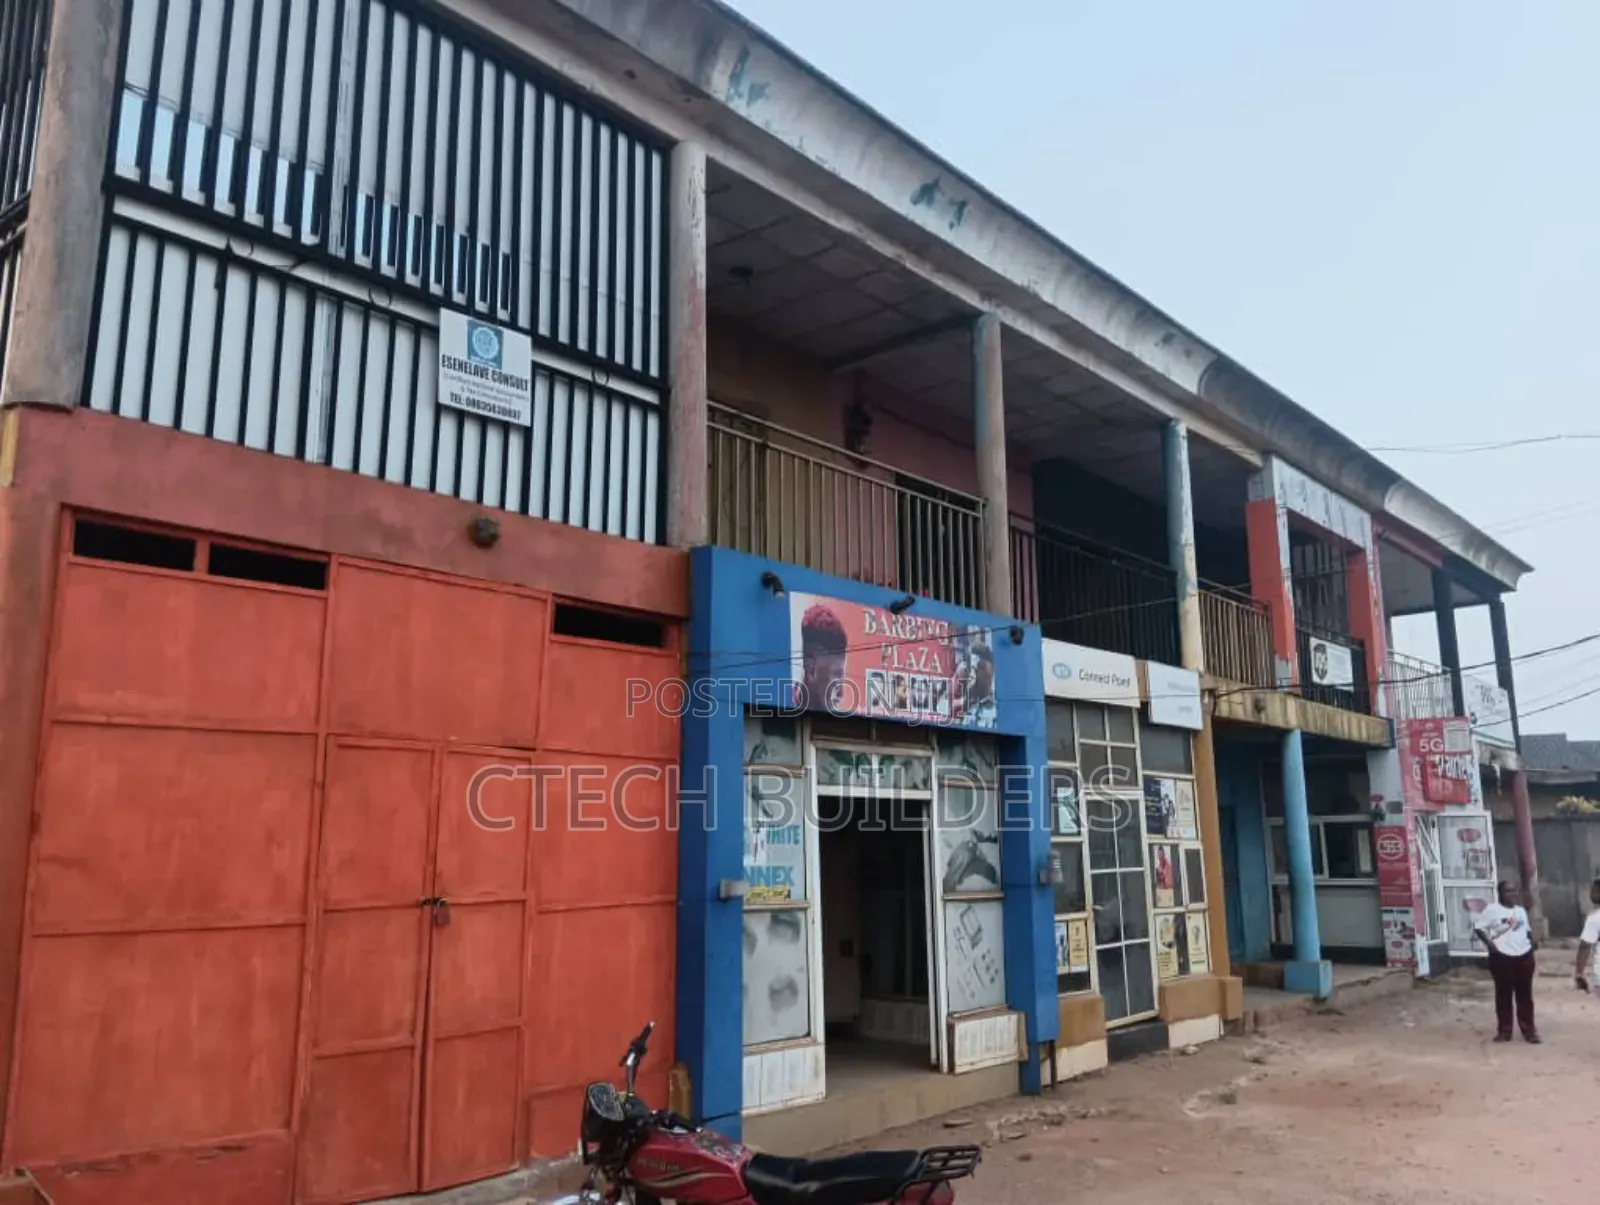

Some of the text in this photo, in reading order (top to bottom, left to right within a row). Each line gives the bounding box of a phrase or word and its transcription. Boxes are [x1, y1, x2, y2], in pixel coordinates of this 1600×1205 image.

[491, 370, 528, 391] CONSULT
[881, 643, 943, 674] PLAZA
[1078, 668, 1110, 684] Connect
[1111, 674, 1131, 688] Point
[1419, 738, 1444, 753] 5G
